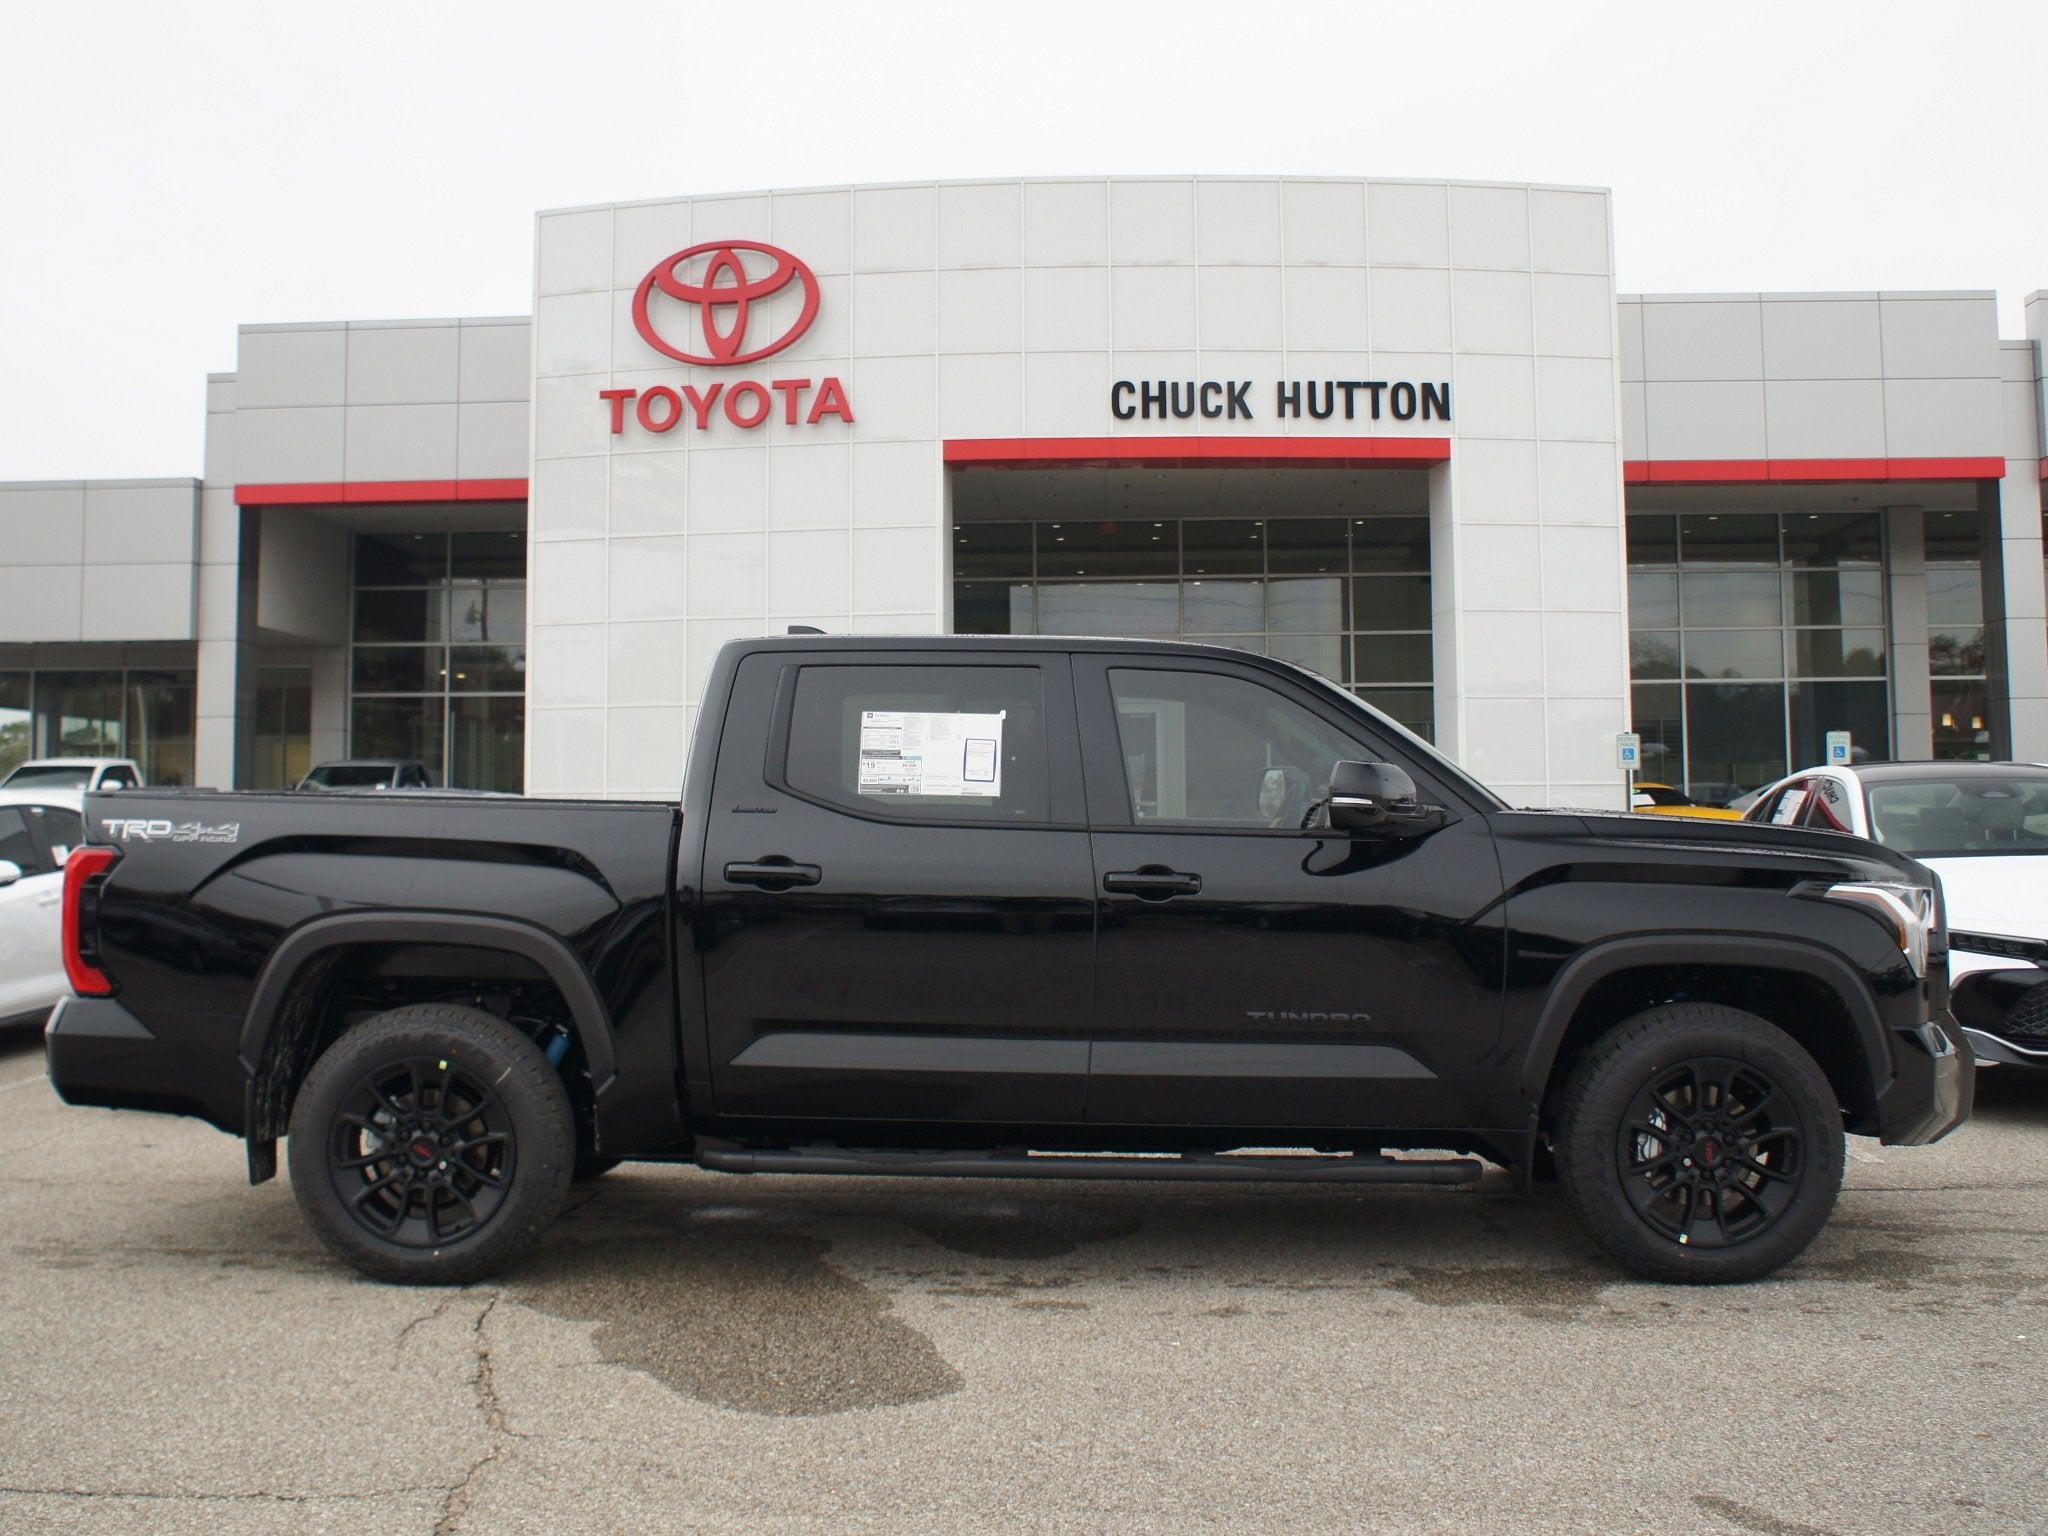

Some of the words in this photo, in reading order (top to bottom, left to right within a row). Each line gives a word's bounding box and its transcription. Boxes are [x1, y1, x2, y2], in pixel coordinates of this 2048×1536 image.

[599, 377, 855, 434] TOYOTA
[1111, 380, 1253, 420] CHUCK
[1276, 380, 1451, 421] HUTTON
[102, 819, 174, 842] TRD
